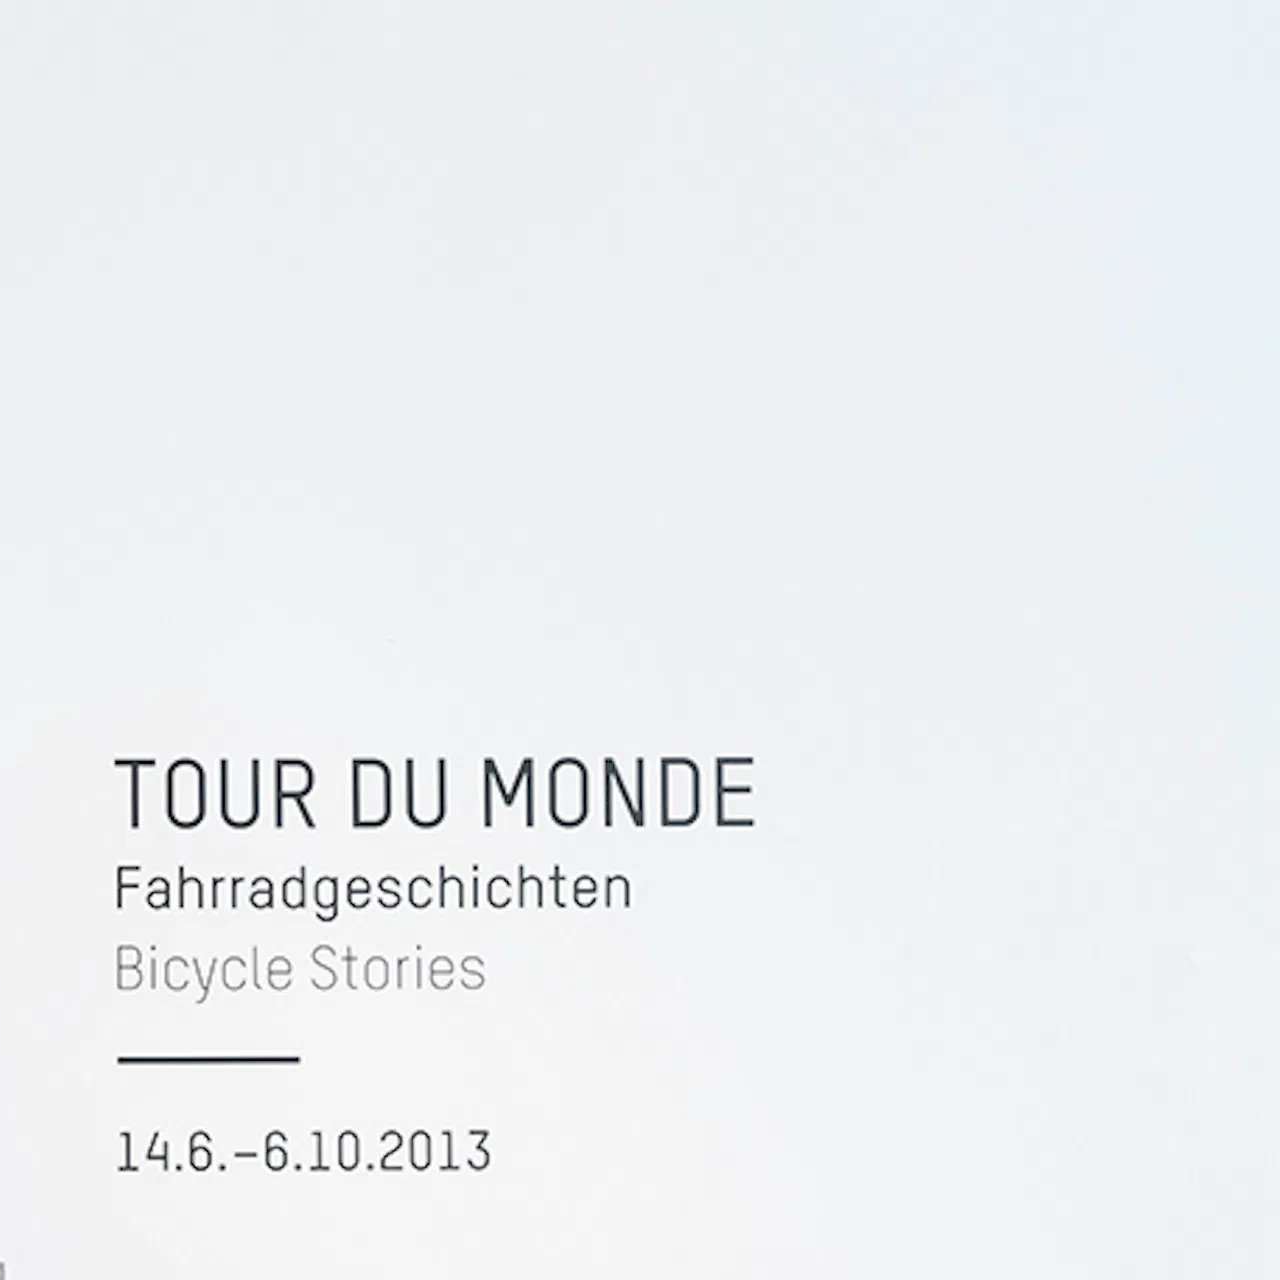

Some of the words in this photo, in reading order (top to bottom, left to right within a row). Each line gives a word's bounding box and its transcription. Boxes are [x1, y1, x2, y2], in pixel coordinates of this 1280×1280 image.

[114, 757, 316, 830] TOUR
[352, 757, 447, 830] DU
[483, 756, 755, 830] MONDE
[116, 864, 631, 923] Fahrradgeschichten
[116, 944, 293, 1004] Bicycle
[311, 944, 486, 992] Stories
